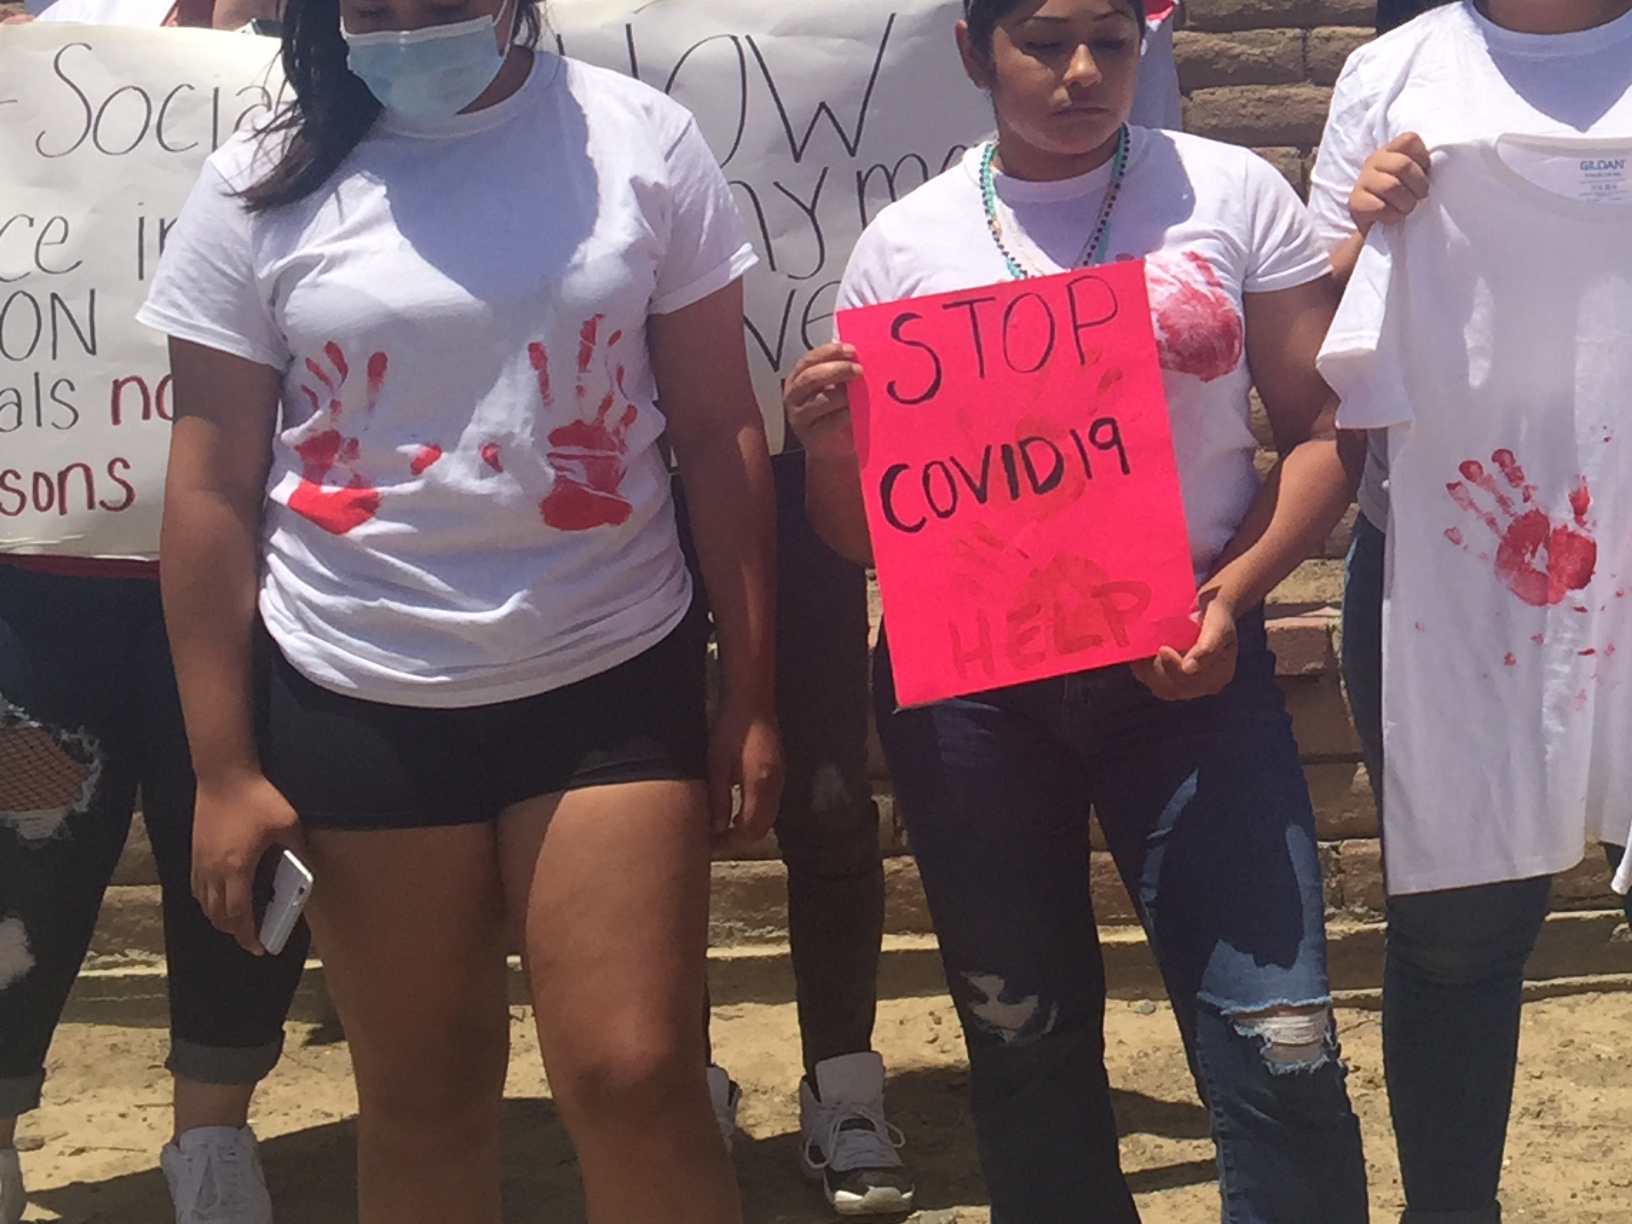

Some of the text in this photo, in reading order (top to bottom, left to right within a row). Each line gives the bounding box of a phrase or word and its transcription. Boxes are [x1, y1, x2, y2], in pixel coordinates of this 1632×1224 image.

[36, 42, 273, 158] Socia
[0, 288, 97, 362] ON
[886, 275, 1119, 406] STOP
[879, 416, 1131, 534] COVID19
[947, 579, 1153, 681] HELP
